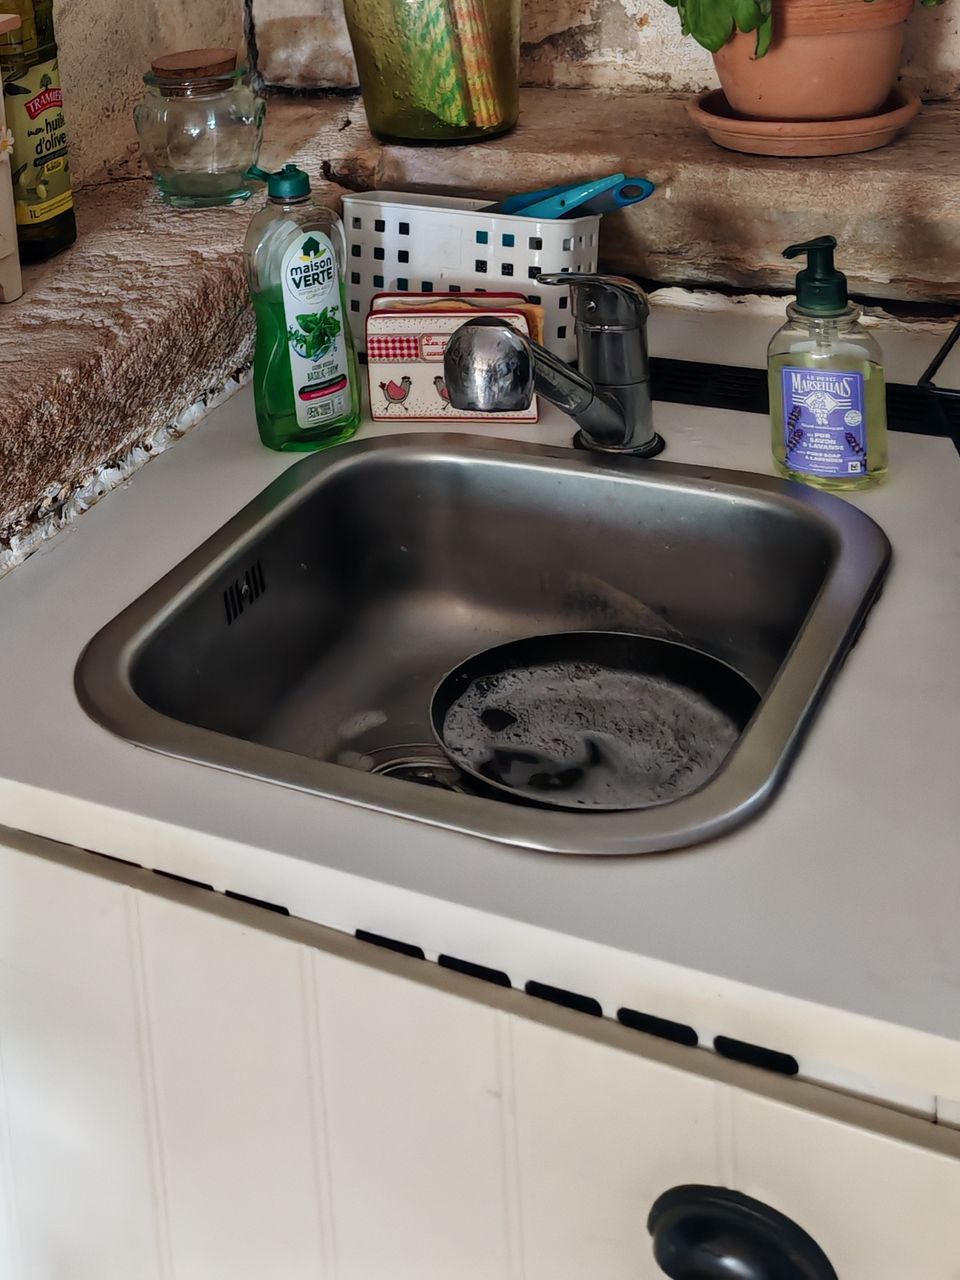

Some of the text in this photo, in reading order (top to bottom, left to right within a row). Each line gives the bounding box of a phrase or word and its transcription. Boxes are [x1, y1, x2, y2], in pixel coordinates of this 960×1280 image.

[35, 132, 66, 155] d'olive
[290, 257, 332, 277] maison
[291, 267, 333, 289] VERTE
